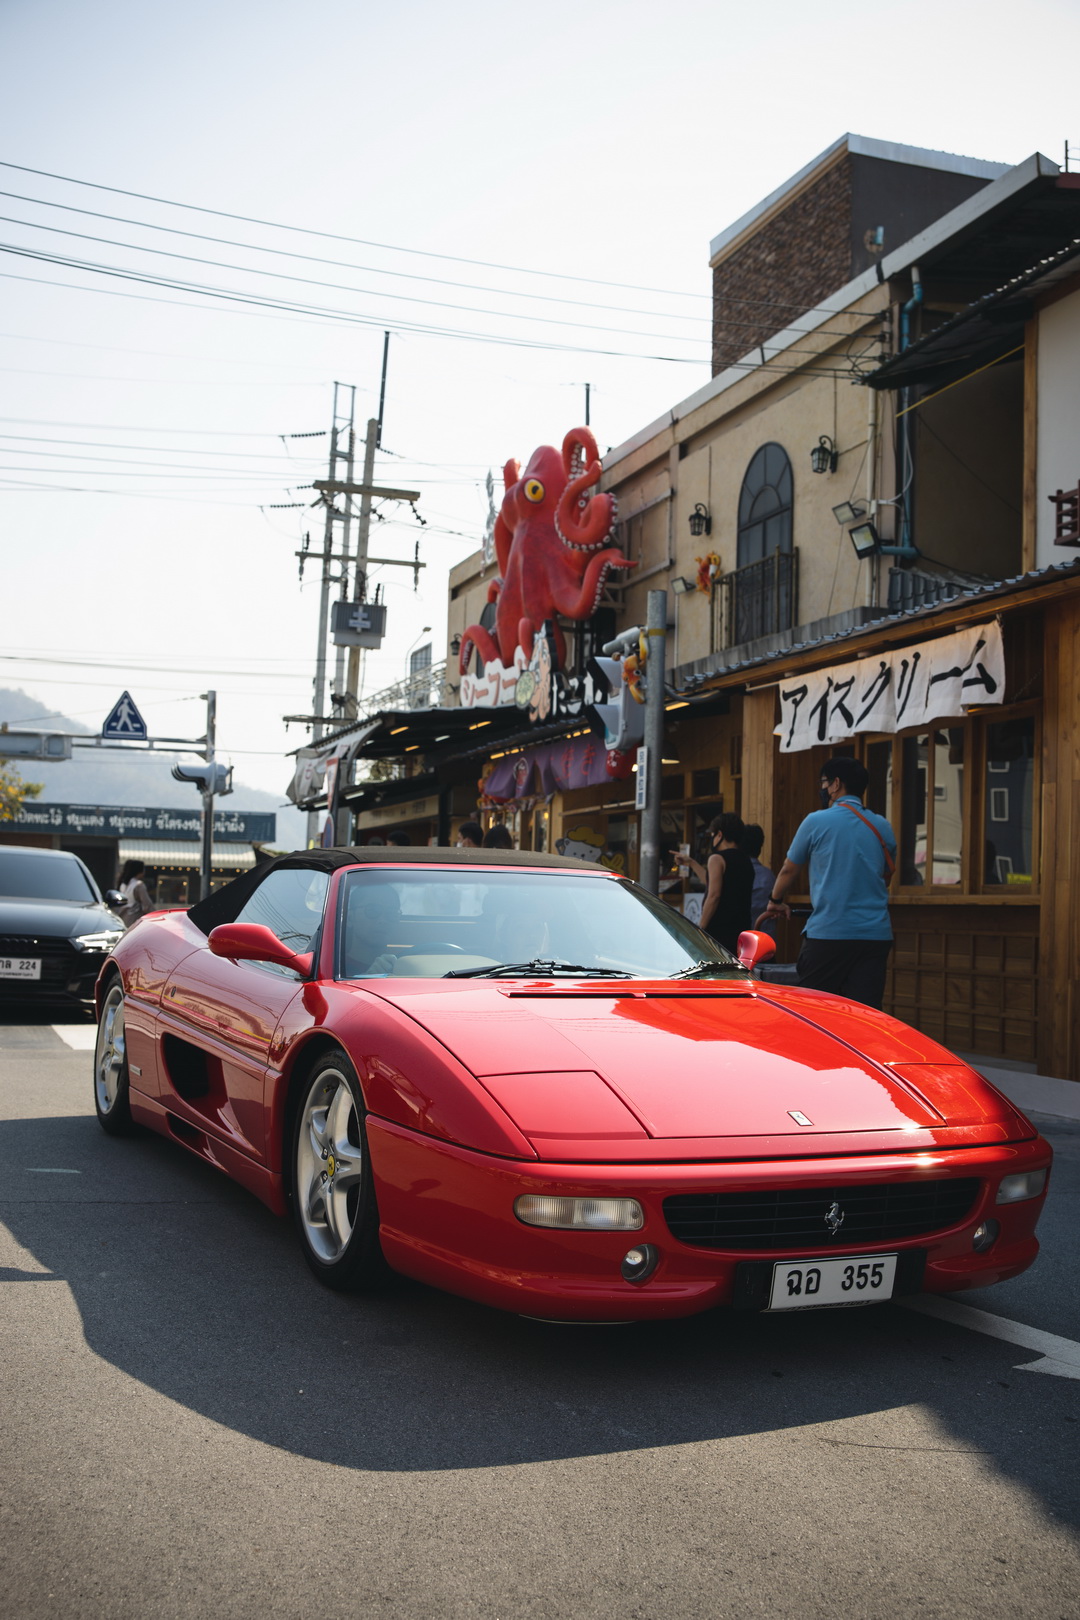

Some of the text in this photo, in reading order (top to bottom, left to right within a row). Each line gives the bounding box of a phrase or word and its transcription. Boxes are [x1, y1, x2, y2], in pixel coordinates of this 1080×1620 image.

[463, 659, 529, 706] シーフー
[782, 639, 997, 748] アイスクリーム
[19, 961, 36, 970] 224
[786, 1262, 885, 1296] ฉอ 355
